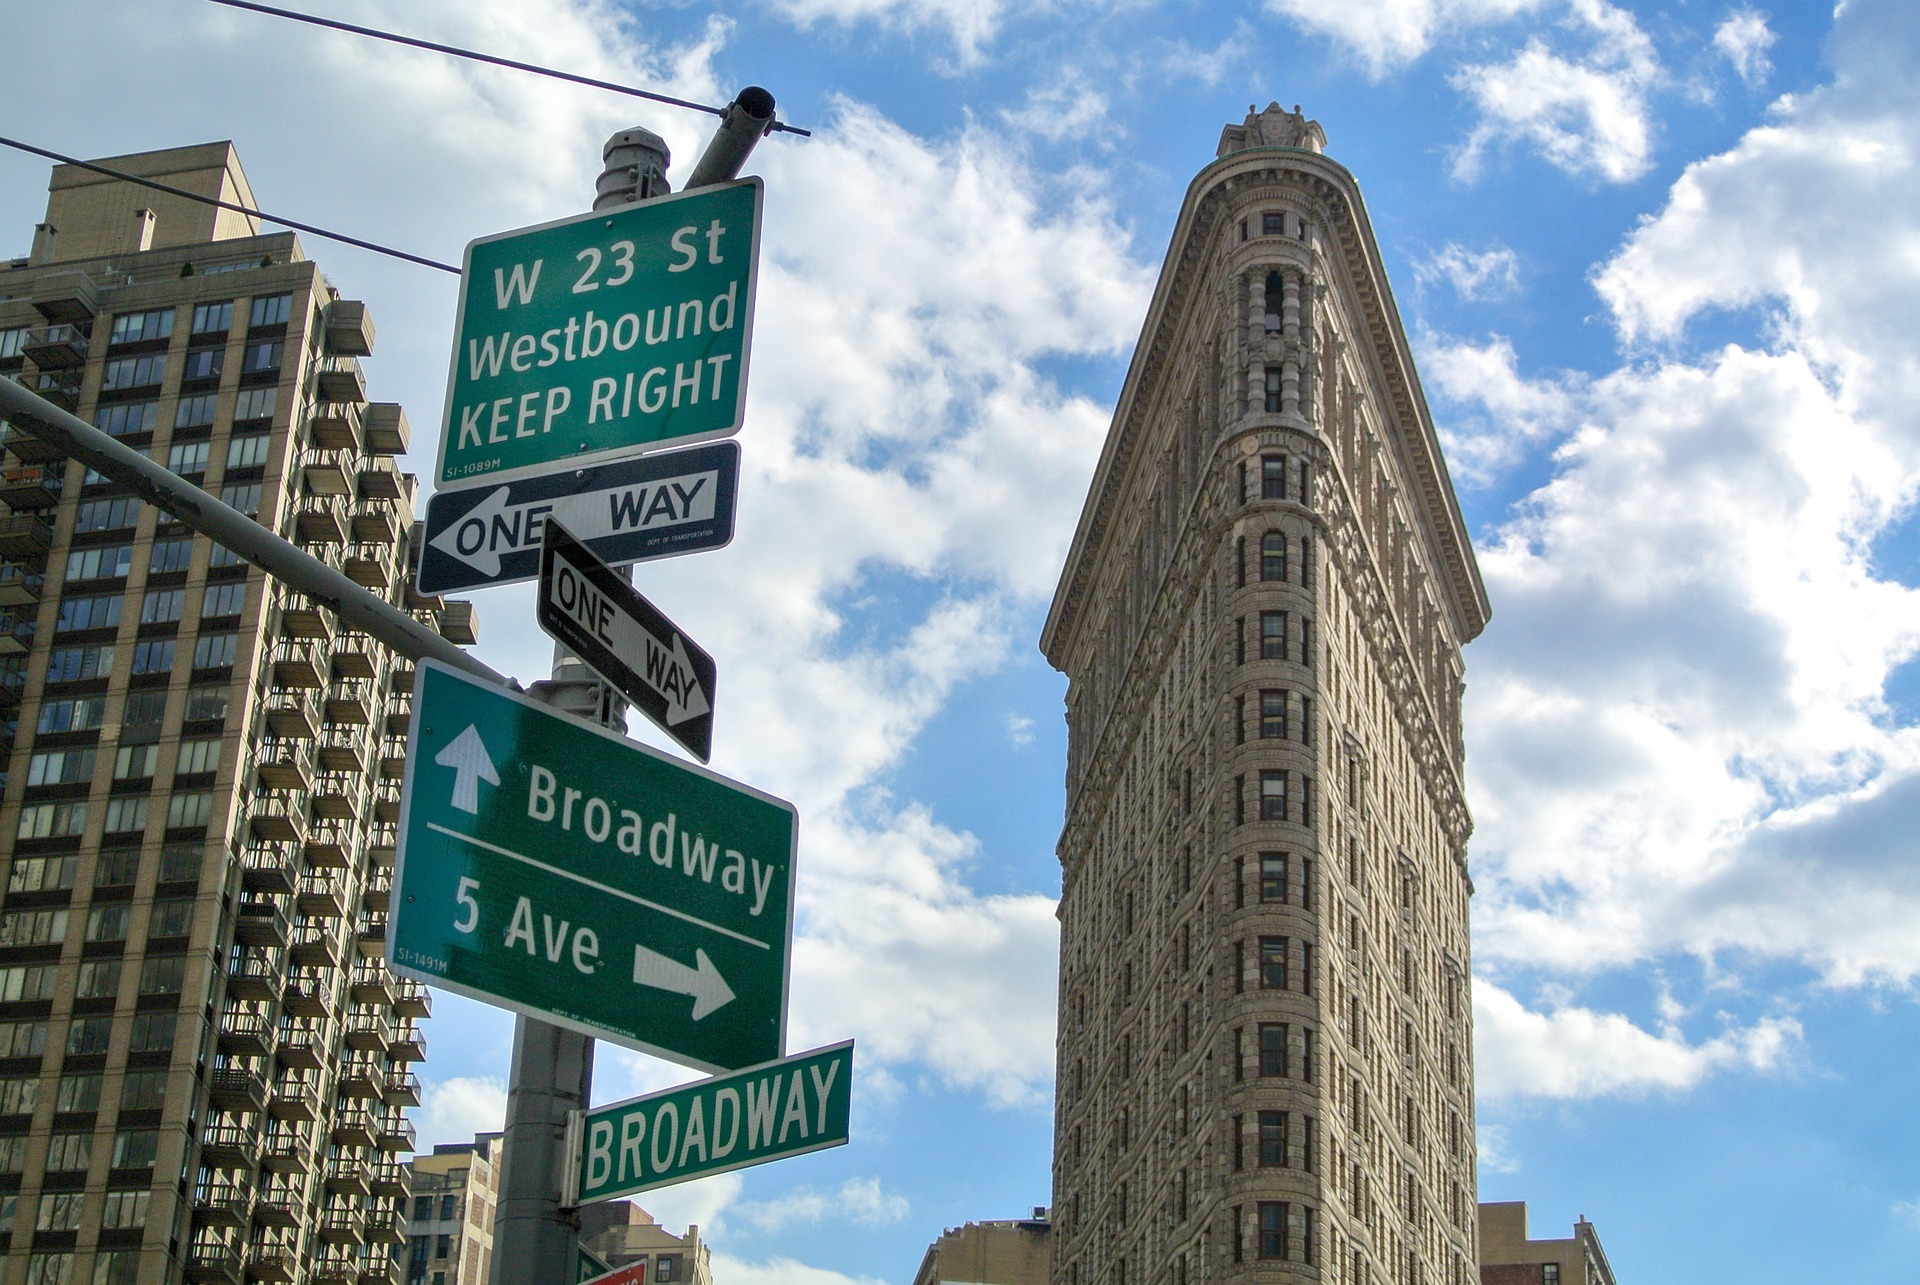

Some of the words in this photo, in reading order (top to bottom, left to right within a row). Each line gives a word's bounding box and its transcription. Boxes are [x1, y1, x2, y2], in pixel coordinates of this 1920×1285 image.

[494, 259, 543, 310] W
[572, 240, 635, 294] 23
[667, 218, 726, 273] St
[469, 281, 737, 381] Westbound
[457, 386, 572, 451] KEEP
[587, 353, 732, 424] RIGHT
[446, 458, 500, 478] SI-1089M
[456, 504, 553, 556] ONE
[610, 478, 706, 531] WAY
[647, 538, 661, 546] DEPT
[671, 529, 714, 542] TRANSPORTATION
[558, 567, 615, 648] ONE
[646, 638, 697, 711] WAY
[527, 764, 774, 916] Broadway
[397, 947, 448, 974] SI-1491M
[453, 876, 480, 934] 5
[504, 896, 600, 974] Ave
[551, 1007, 568, 1017] DEPT
[583, 1017, 636, 1038] TRANSPORTATION
[586, 1058, 841, 1190] BROADWAY
